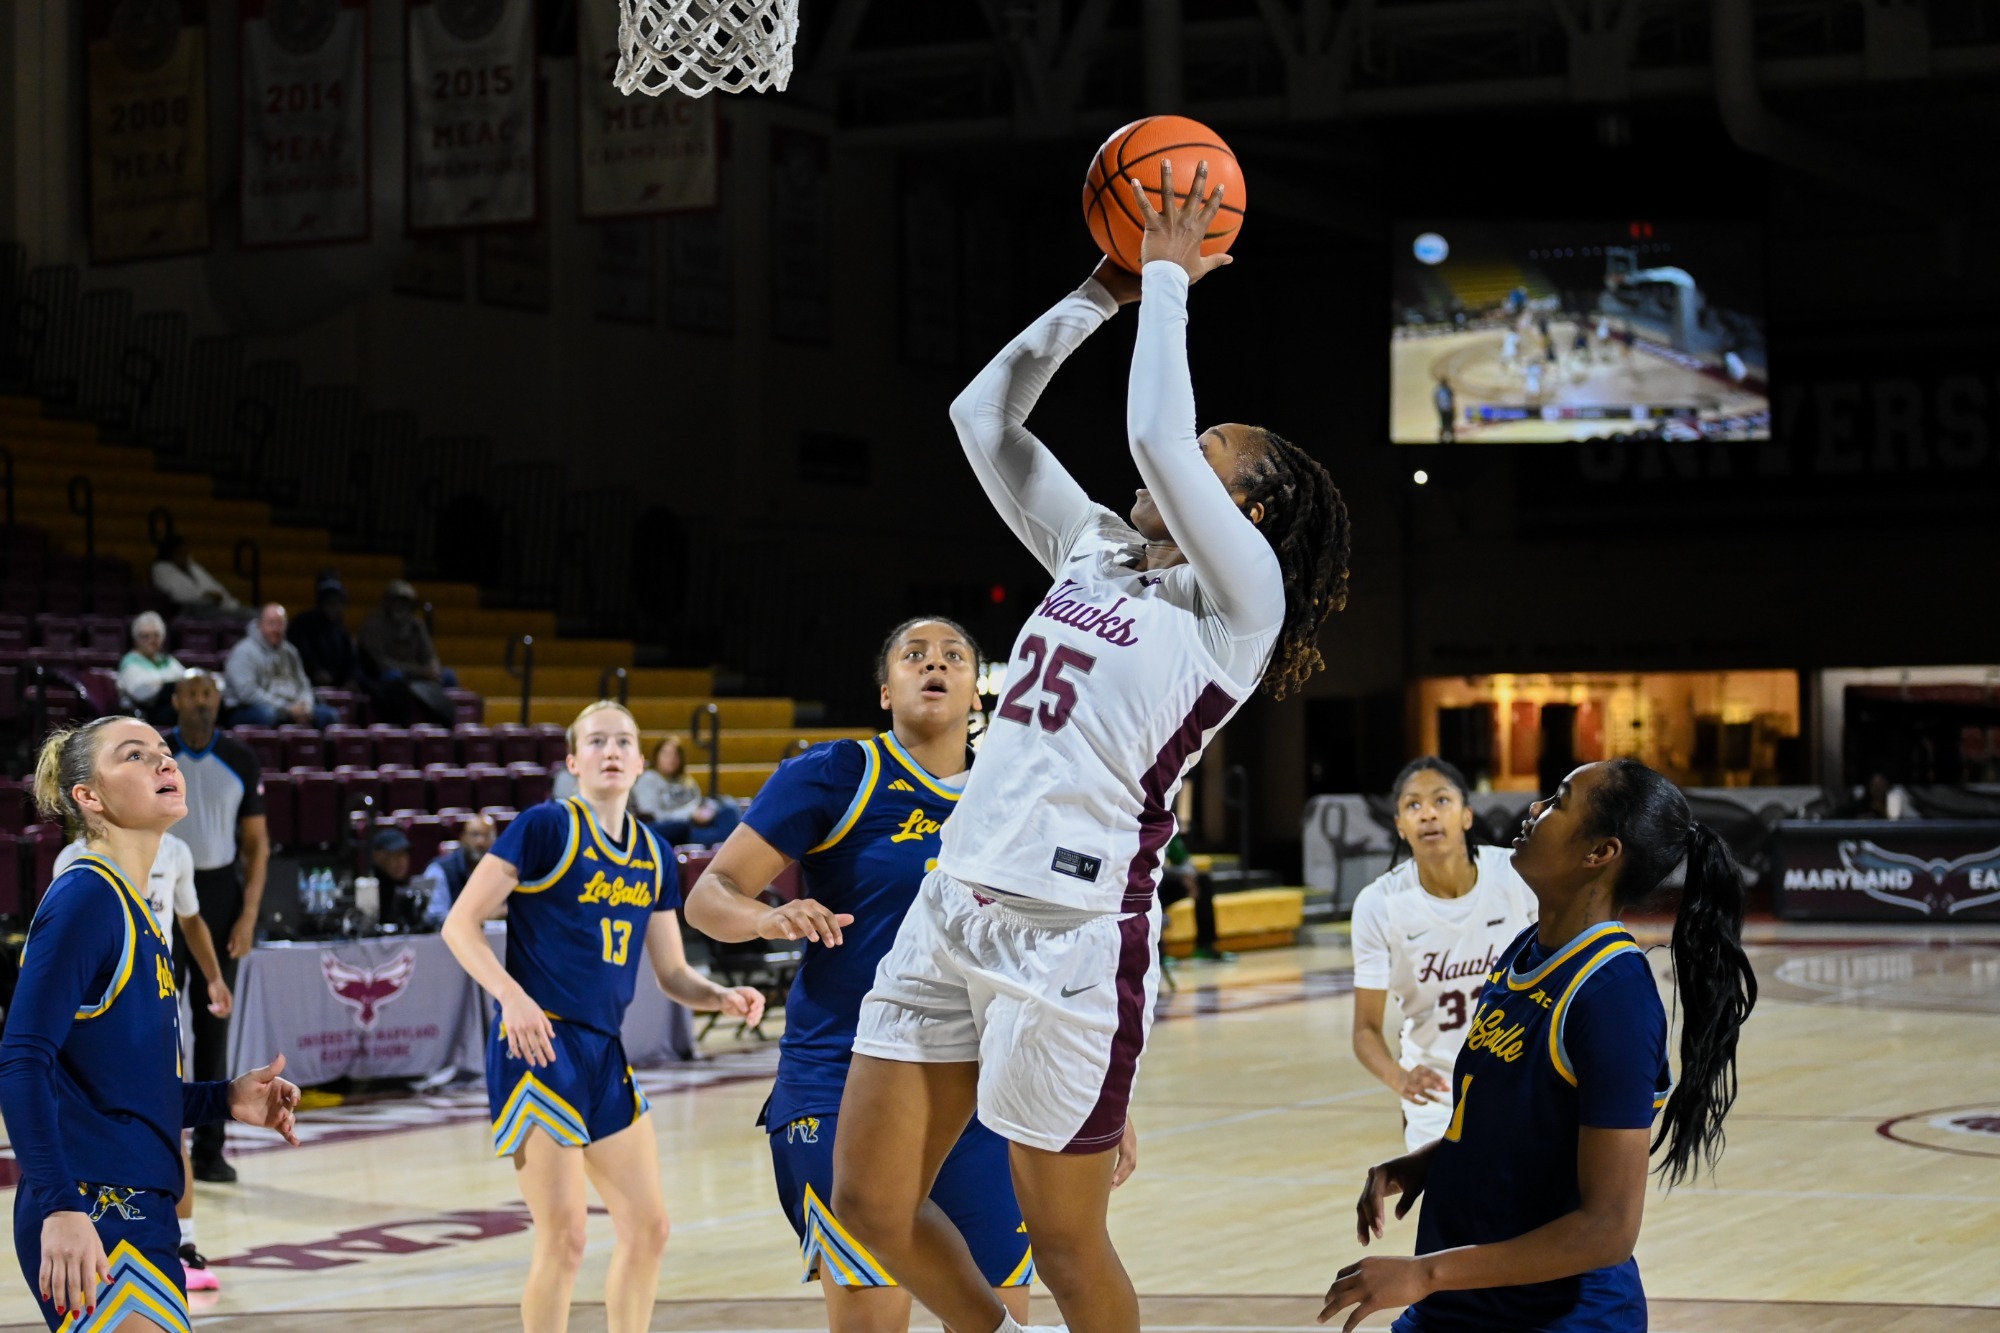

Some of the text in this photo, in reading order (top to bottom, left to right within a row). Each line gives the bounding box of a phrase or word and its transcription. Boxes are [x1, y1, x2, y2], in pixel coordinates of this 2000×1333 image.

[266, 79, 343, 114] 2014
[433, 64, 514, 98] 2015
[109, 94, 188, 134] 2008
[604, 100, 692, 131] MEAC
[263, 130, 343, 165] MEAC
[433, 116, 516, 149] MEAC
[1037, 578, 1139, 647] Hawks
[997, 632, 1098, 736] 25
[1083, 862, 1094, 873] M
[1783, 868, 2000, 890] MARYLAND EA
[600, 917, 633, 966] 13
[1418, 943, 1500, 983] Hawk
